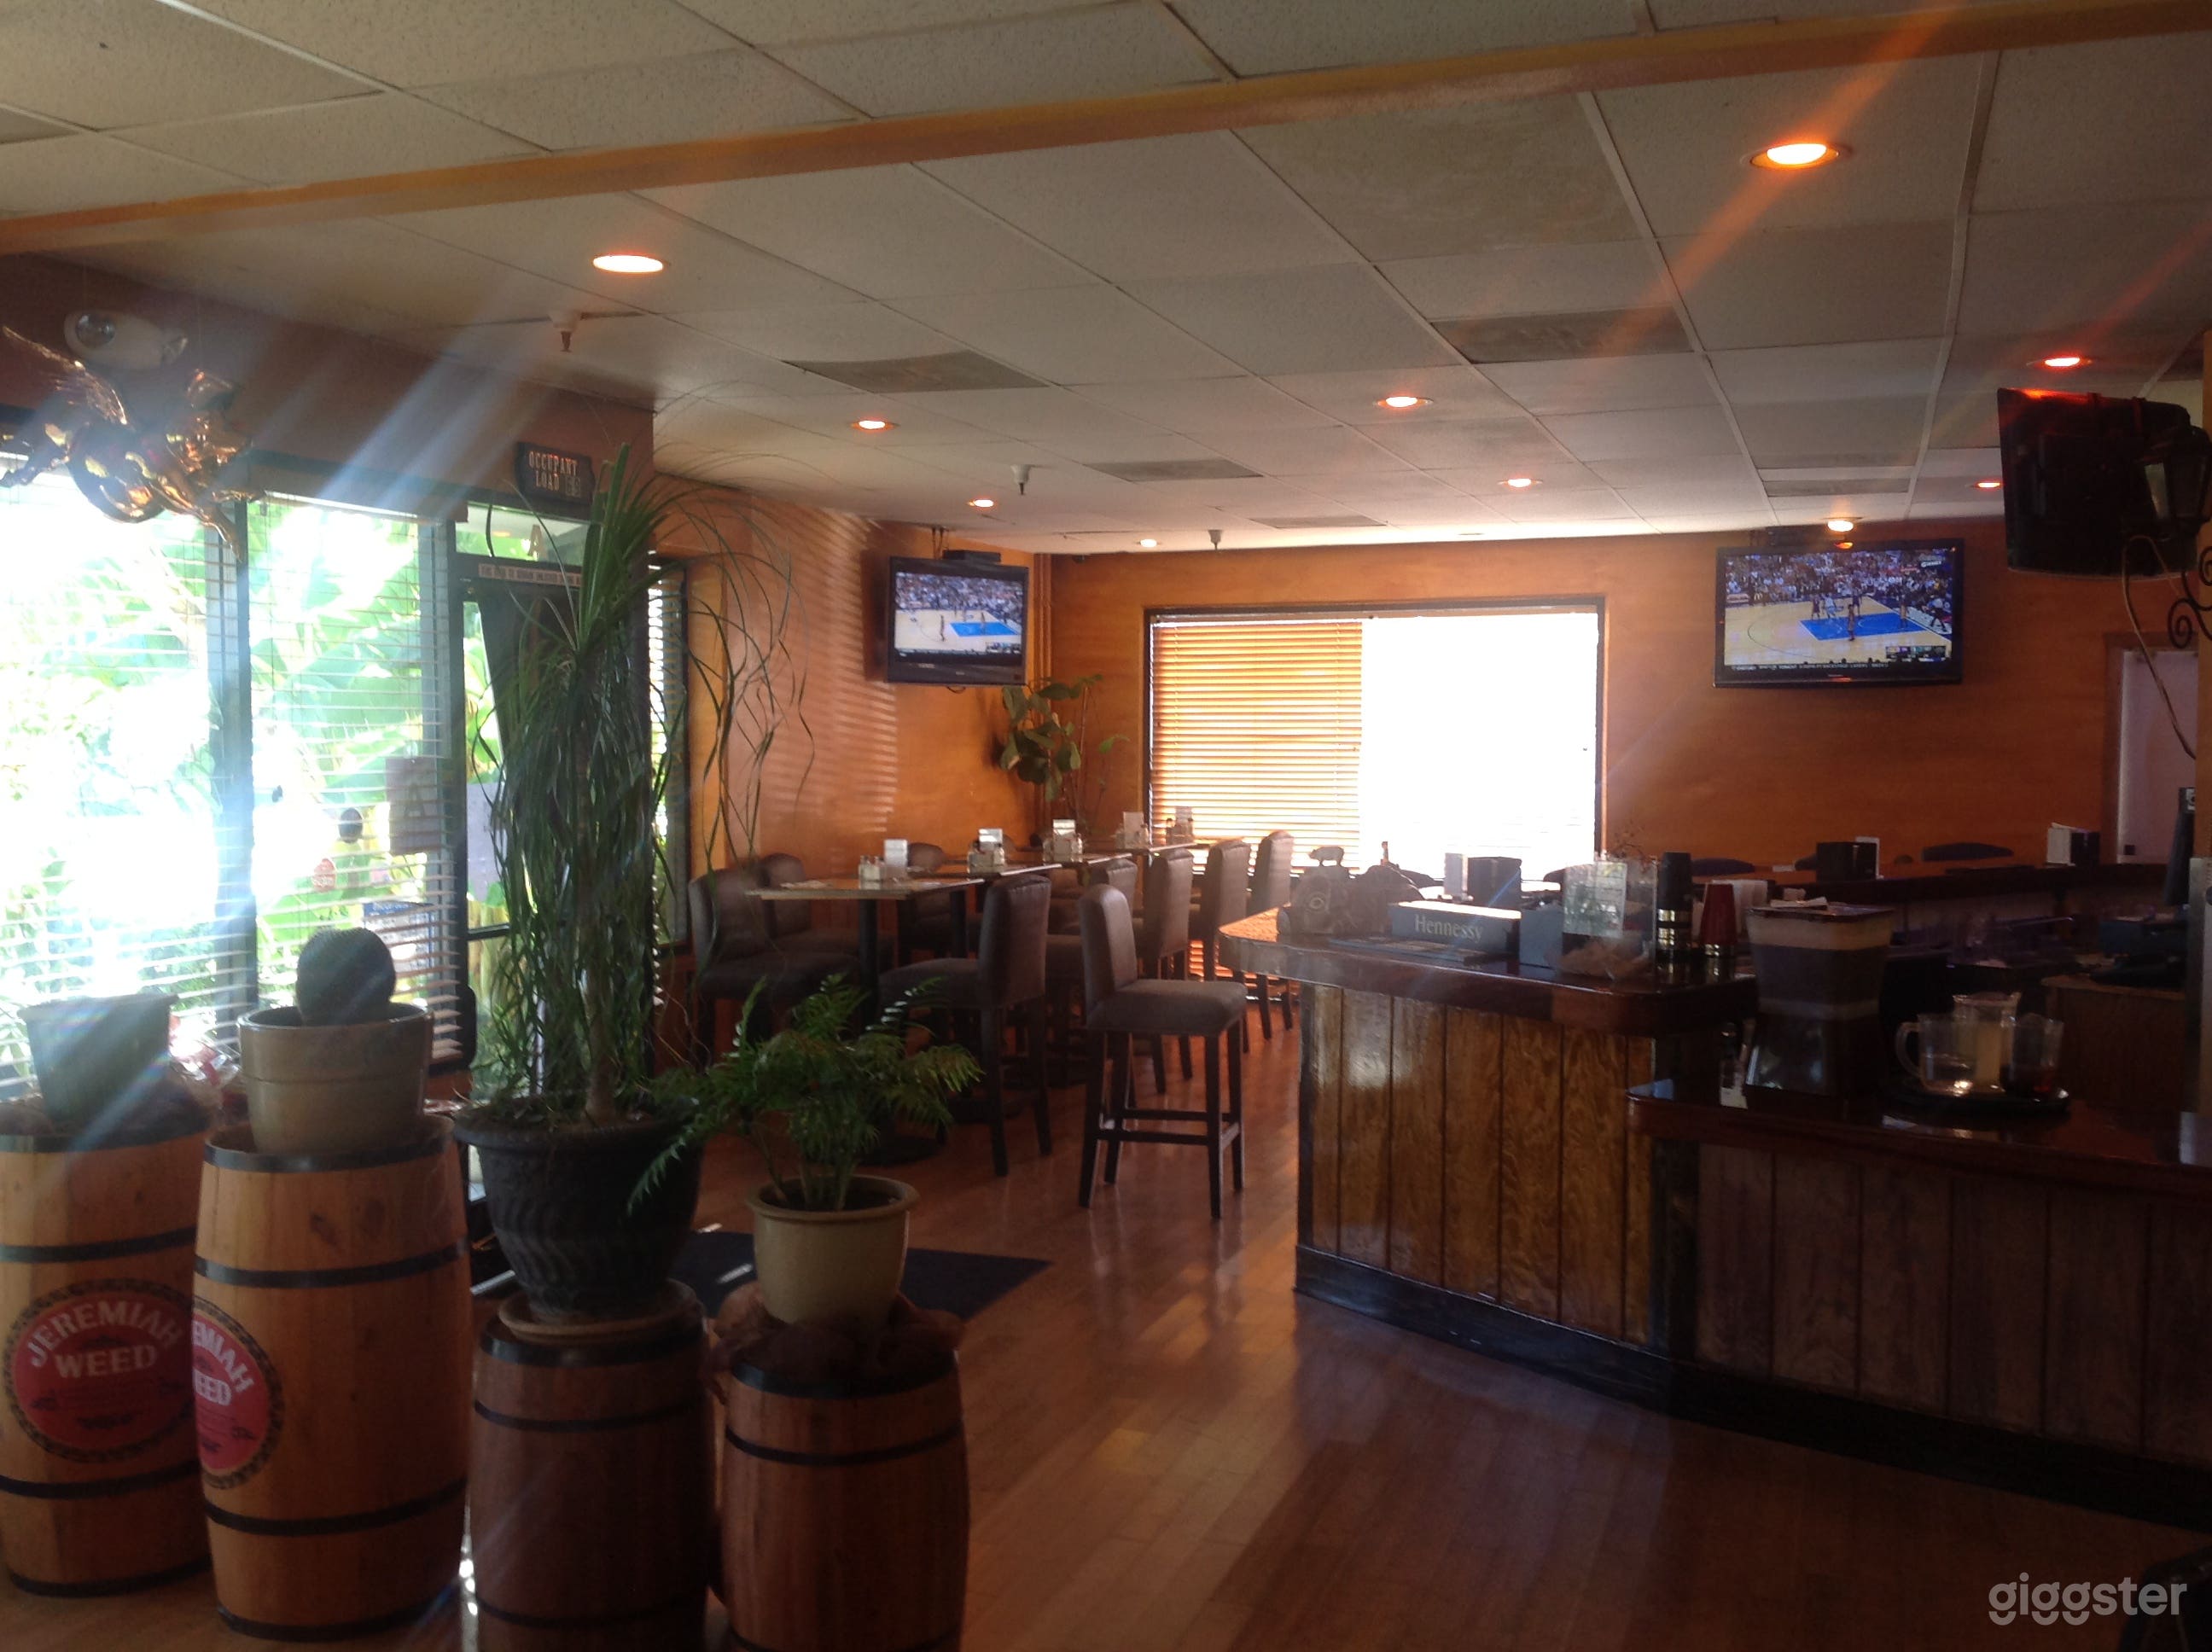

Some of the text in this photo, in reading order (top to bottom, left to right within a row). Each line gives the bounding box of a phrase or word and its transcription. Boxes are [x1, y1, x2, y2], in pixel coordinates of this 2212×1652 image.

[528, 451, 578, 476] OCCUPANT
[535, 470, 560, 492] LOAD
[1414, 913, 1484, 944] Hennessy
[27, 1300, 183, 1367] JEREMIAH
[55, 1344, 157, 1379] WEED
[192, 1320, 255, 1393] EMIAH
[194, 1369, 232, 1406] EED
